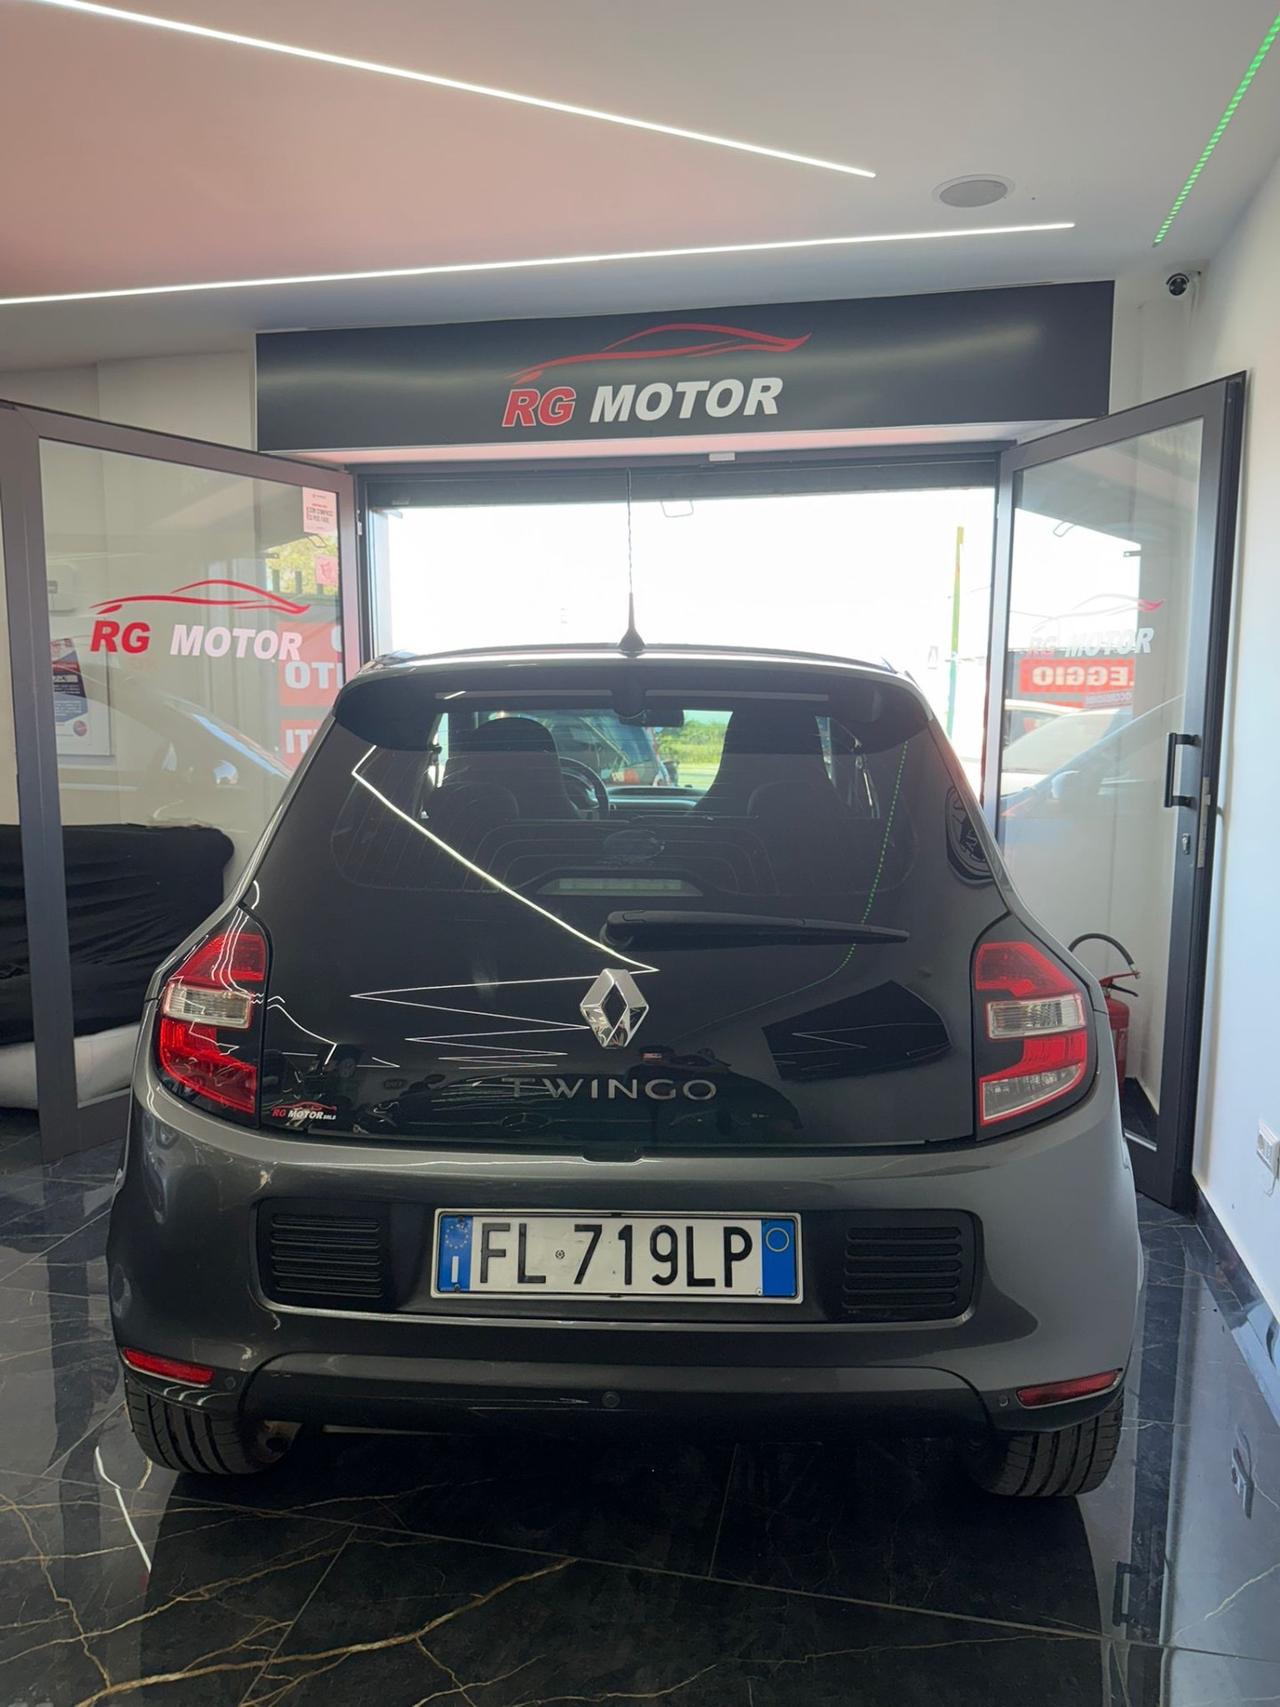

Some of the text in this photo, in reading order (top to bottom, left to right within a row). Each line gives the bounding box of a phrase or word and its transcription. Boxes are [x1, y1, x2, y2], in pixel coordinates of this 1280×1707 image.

[502, 377, 784, 428] RG MOTOR
[90, 619, 151, 655] RG
[170, 623, 303, 661] MOTOR
[1065, 628, 1154, 657] MOTOR
[502, 1077, 718, 1101] TWINGO
[287, 1109, 323, 1119] MOTOR
[480, 1222, 547, 1285] FL
[573, 1224, 753, 1288] 719LP
